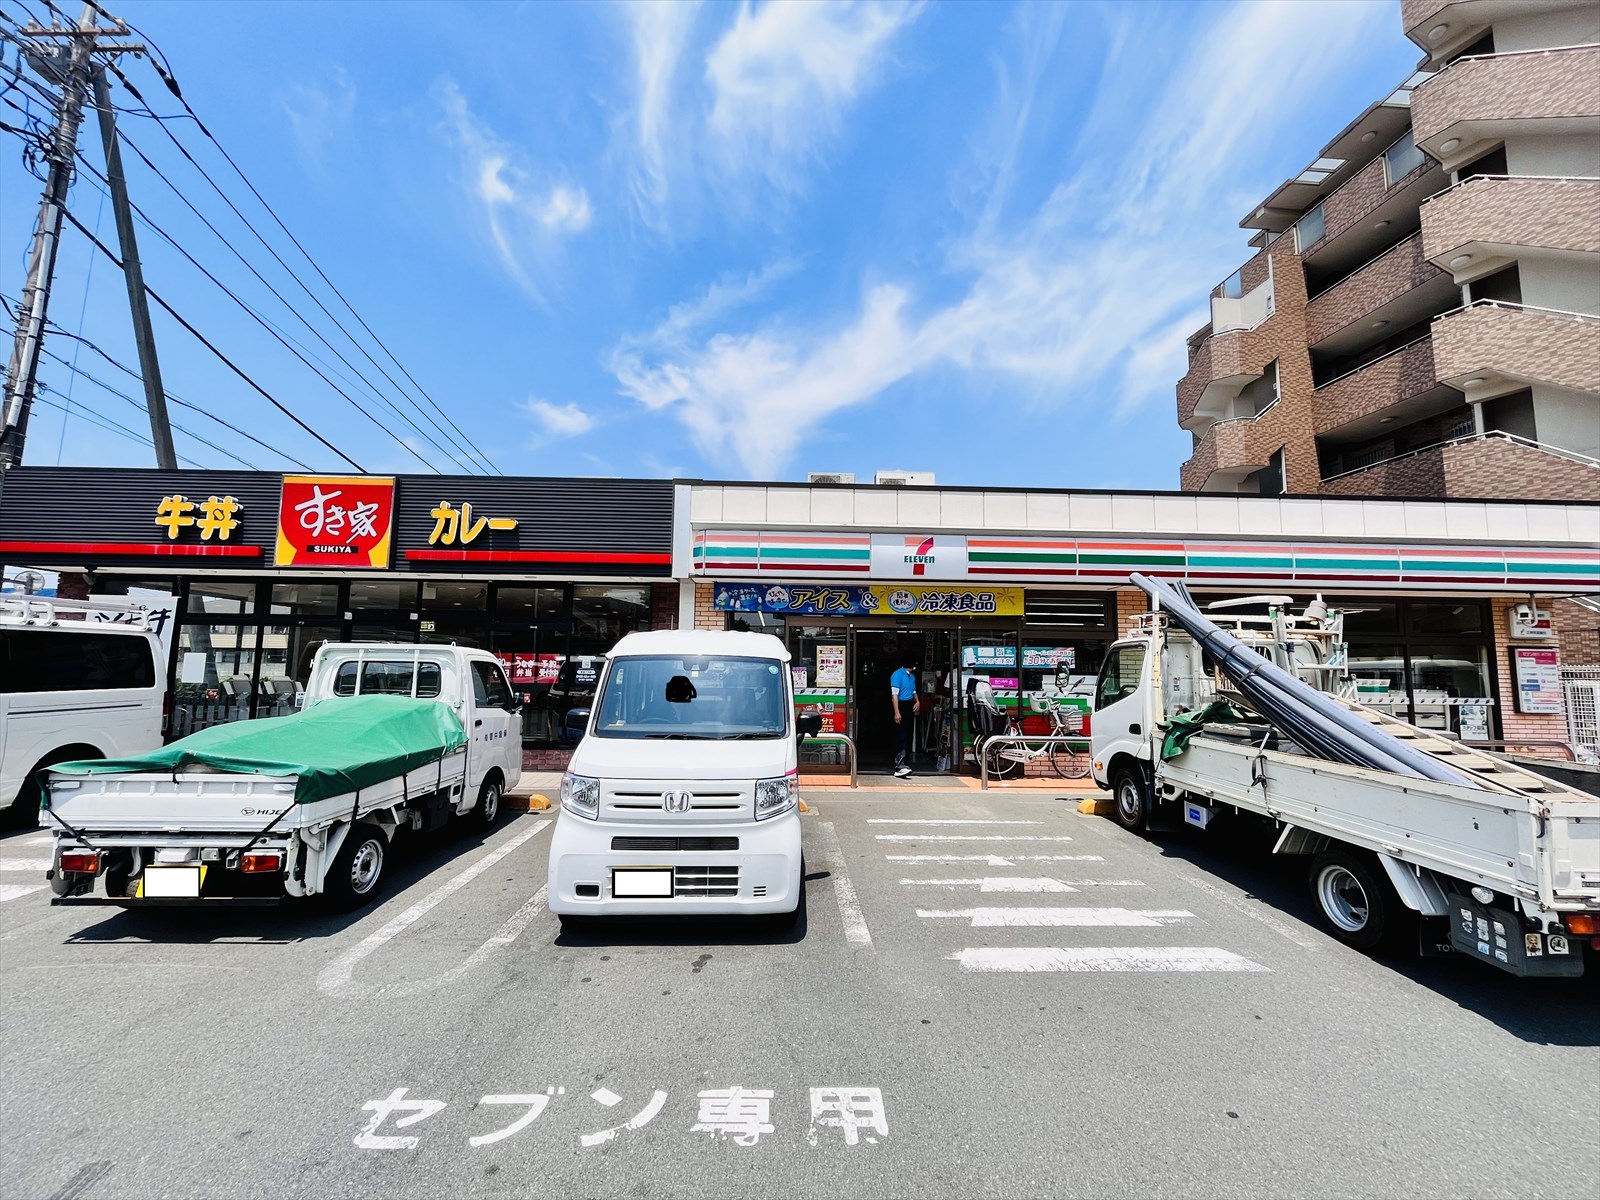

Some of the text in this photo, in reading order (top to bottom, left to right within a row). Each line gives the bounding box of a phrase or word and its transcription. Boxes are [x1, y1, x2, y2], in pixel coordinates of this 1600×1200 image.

[155, 494, 243, 540] 牛丼
[294, 485, 379, 544] すき家
[428, 501, 518, 545] カレー
[313, 545, 352, 553] SUKIYA
[790, 588, 879, 611] アイス &
[920, 592, 995, 612] 冷凍食品
[516, 669, 533, 677] 弁当
[541, 660, 557, 668] 予約
[353, 1086, 888, 1150] セブン専用
